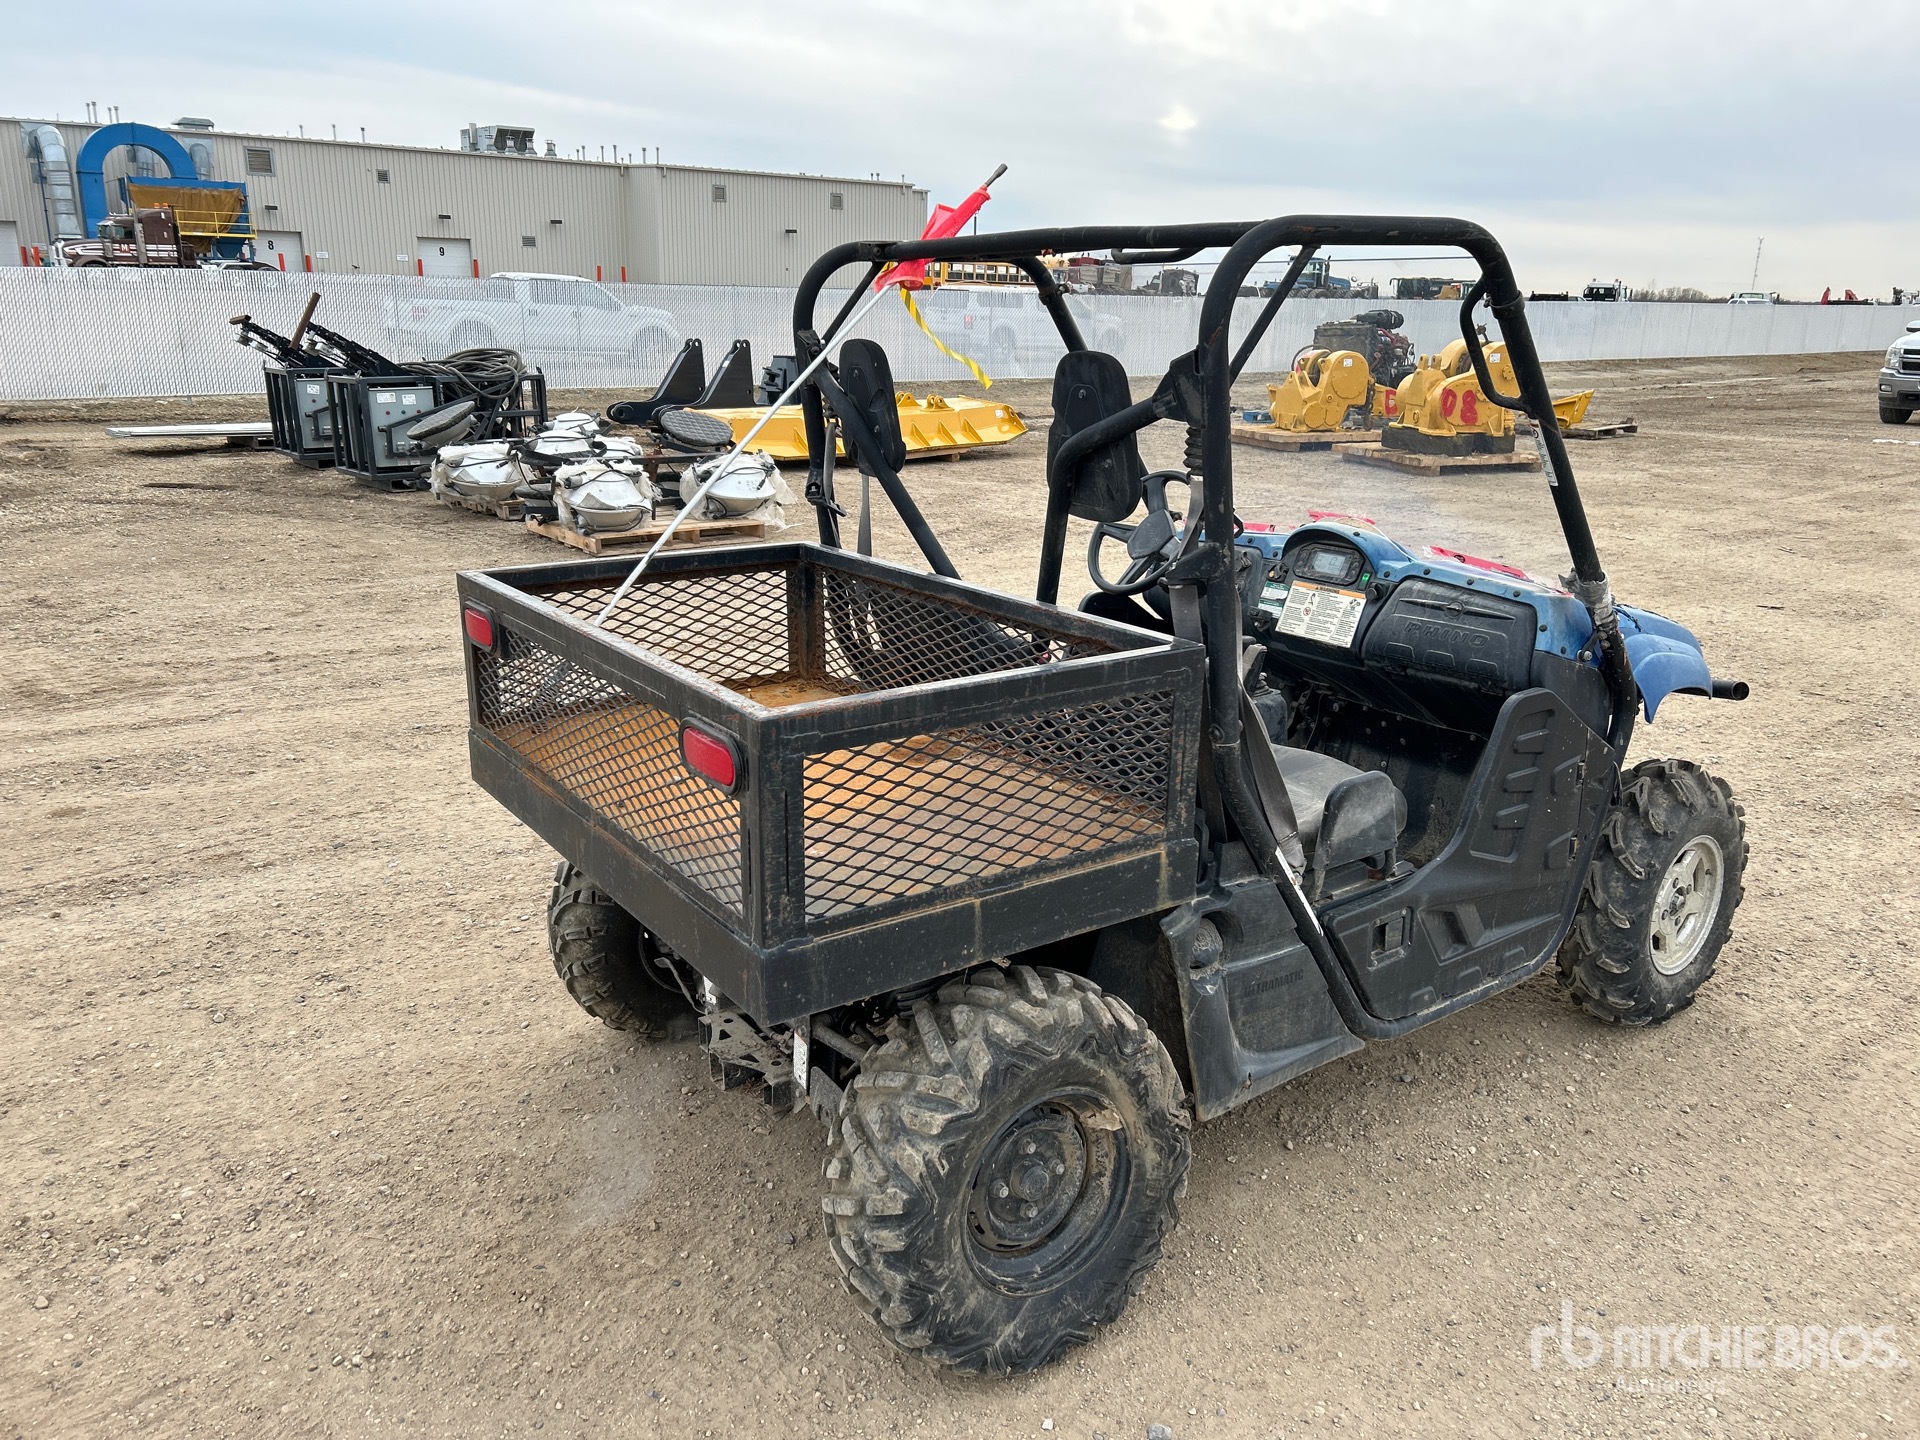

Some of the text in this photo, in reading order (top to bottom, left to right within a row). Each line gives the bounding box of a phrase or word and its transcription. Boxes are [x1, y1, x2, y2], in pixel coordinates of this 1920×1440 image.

[267, 240, 275, 250] 8
[439, 246, 445, 256] 9
[1404, 620, 1490, 648] RHINO
